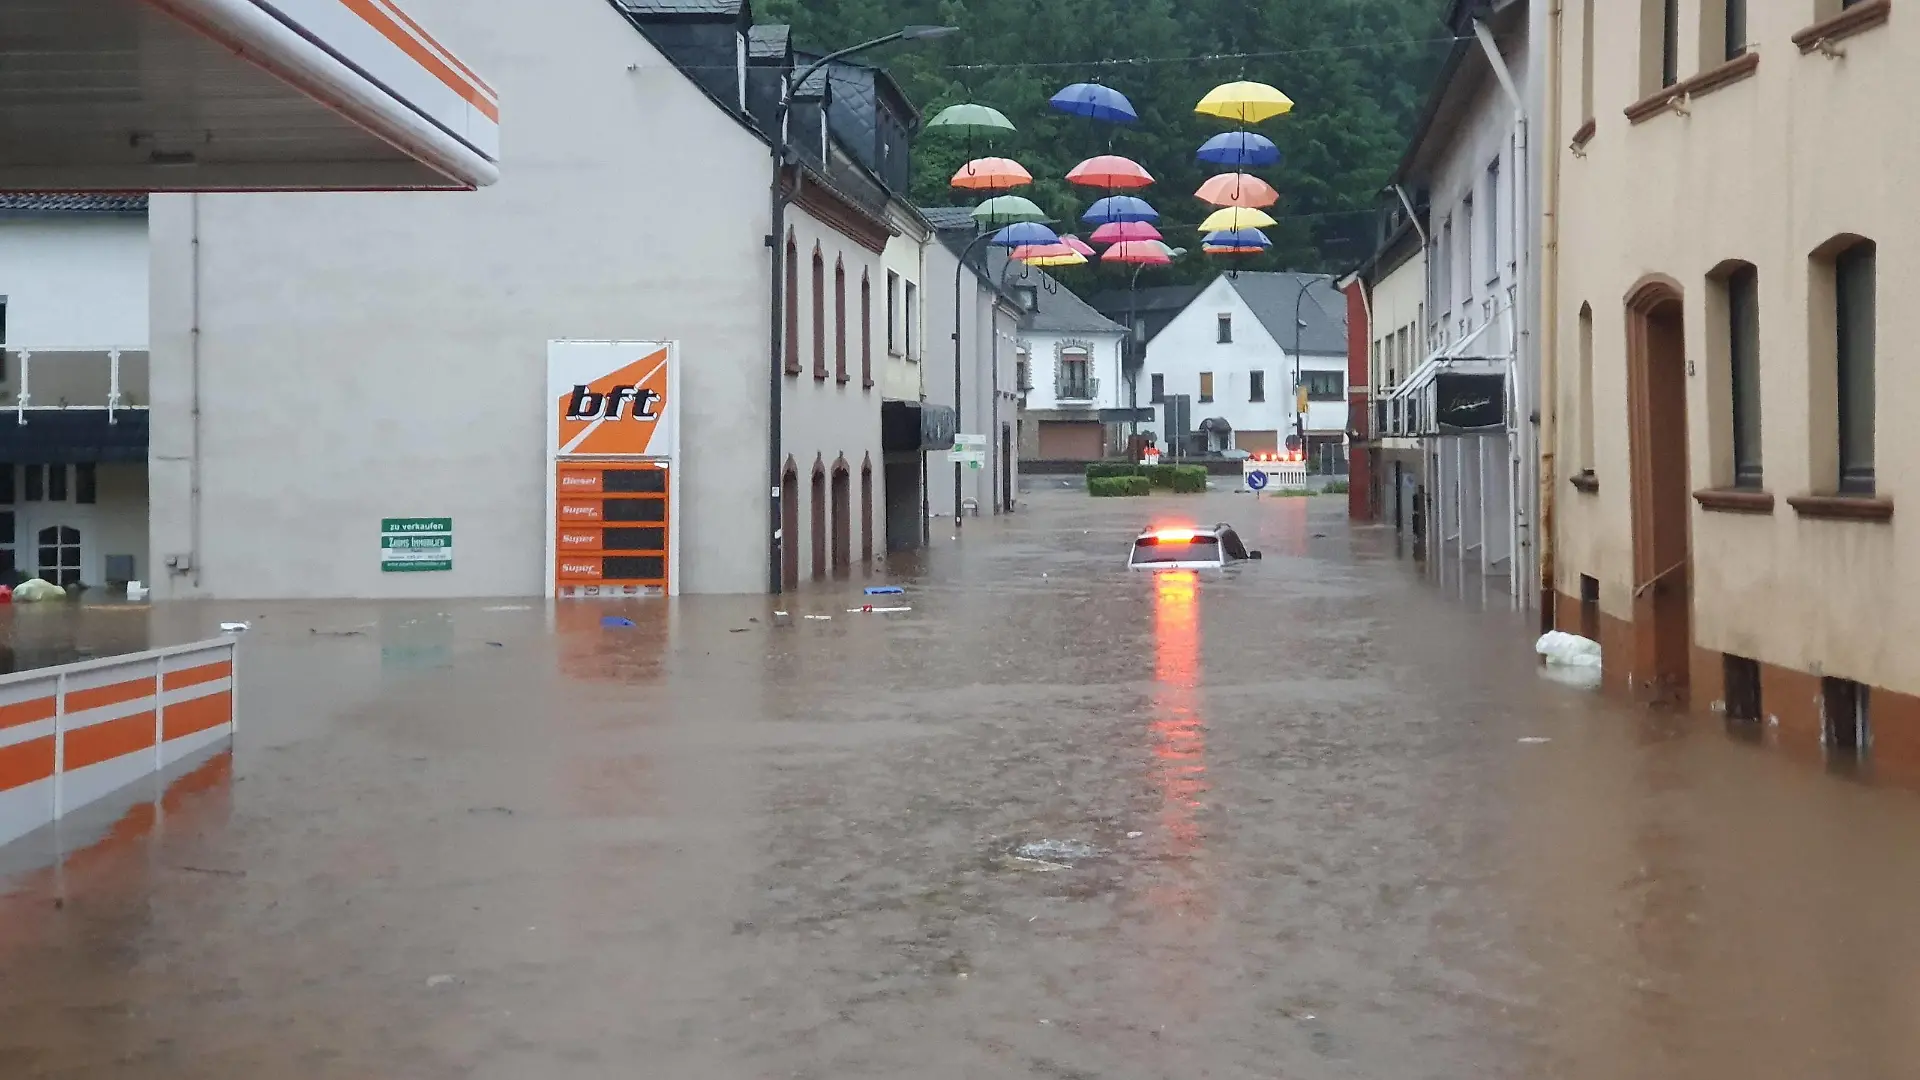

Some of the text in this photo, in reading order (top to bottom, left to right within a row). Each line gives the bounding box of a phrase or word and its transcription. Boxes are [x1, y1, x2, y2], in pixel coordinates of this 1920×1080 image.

[565, 385, 661, 421] bft
[562, 477, 596, 485] Diesel
[562, 505, 595, 515] Super
[402, 522, 444, 530] verkaufen
[562, 534, 595, 544] Super
[562, 563, 595, 573] Super
